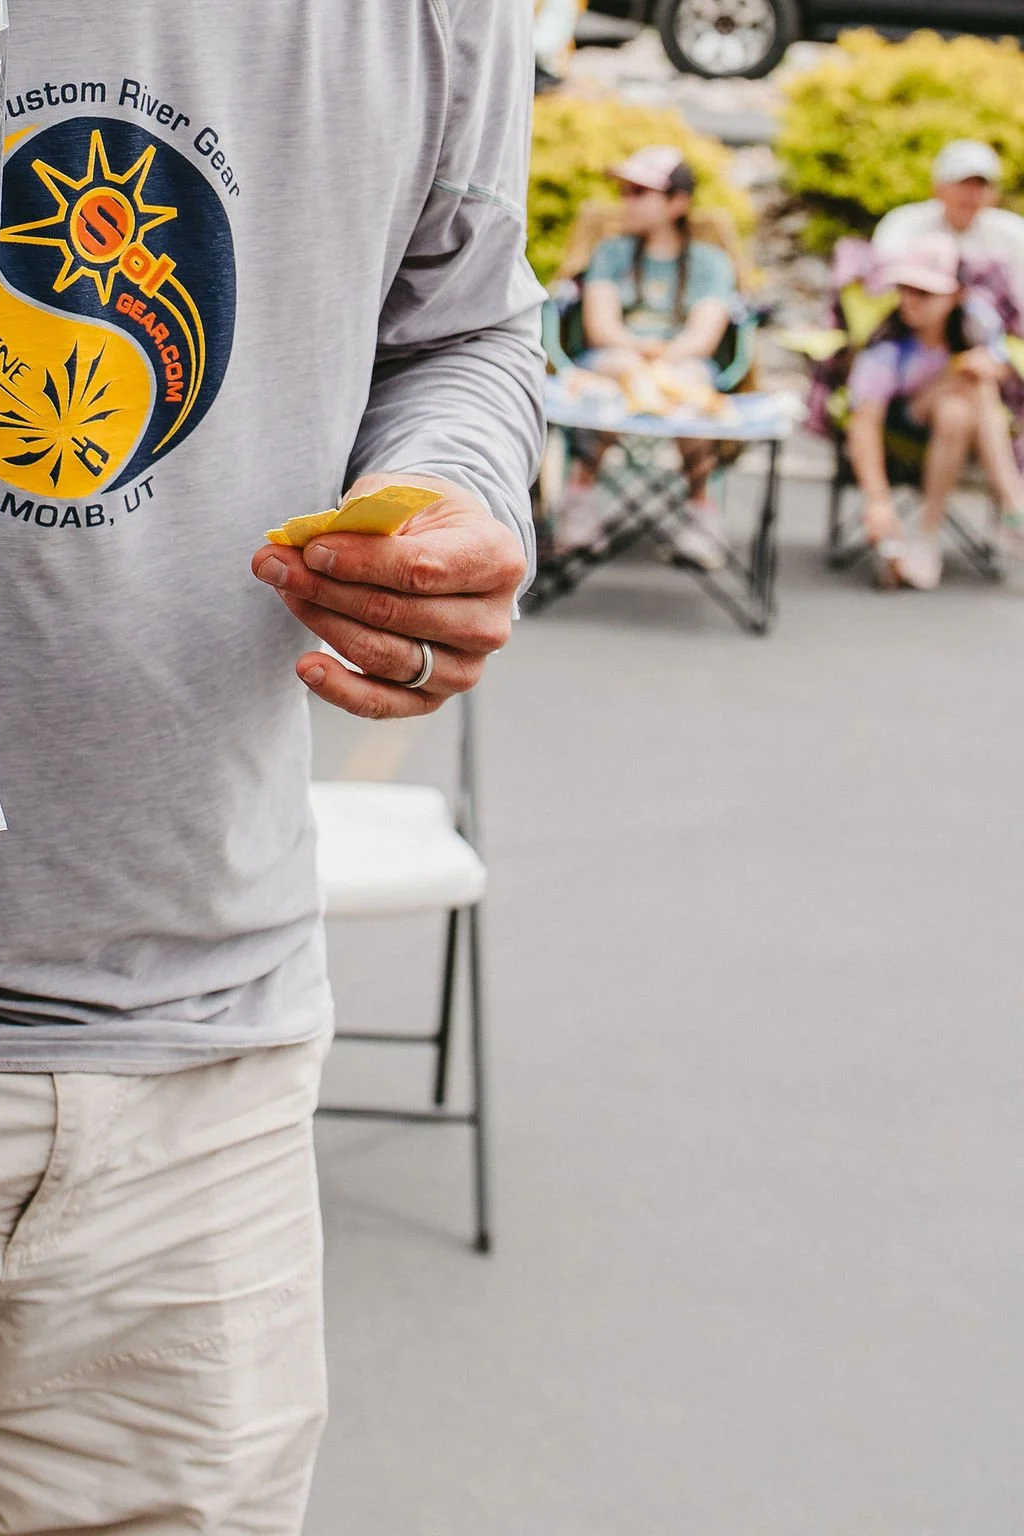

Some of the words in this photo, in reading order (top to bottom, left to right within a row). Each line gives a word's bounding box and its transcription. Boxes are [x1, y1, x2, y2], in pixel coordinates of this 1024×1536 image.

[5, 81, 106, 121] ustom
[118, 78, 190, 132] River
[193, 126, 241, 197] Gear
[115, 292, 184, 403] GEAR.COM
[0, 491, 115, 530] MOAB,
[123, 475, 154, 514] UT
